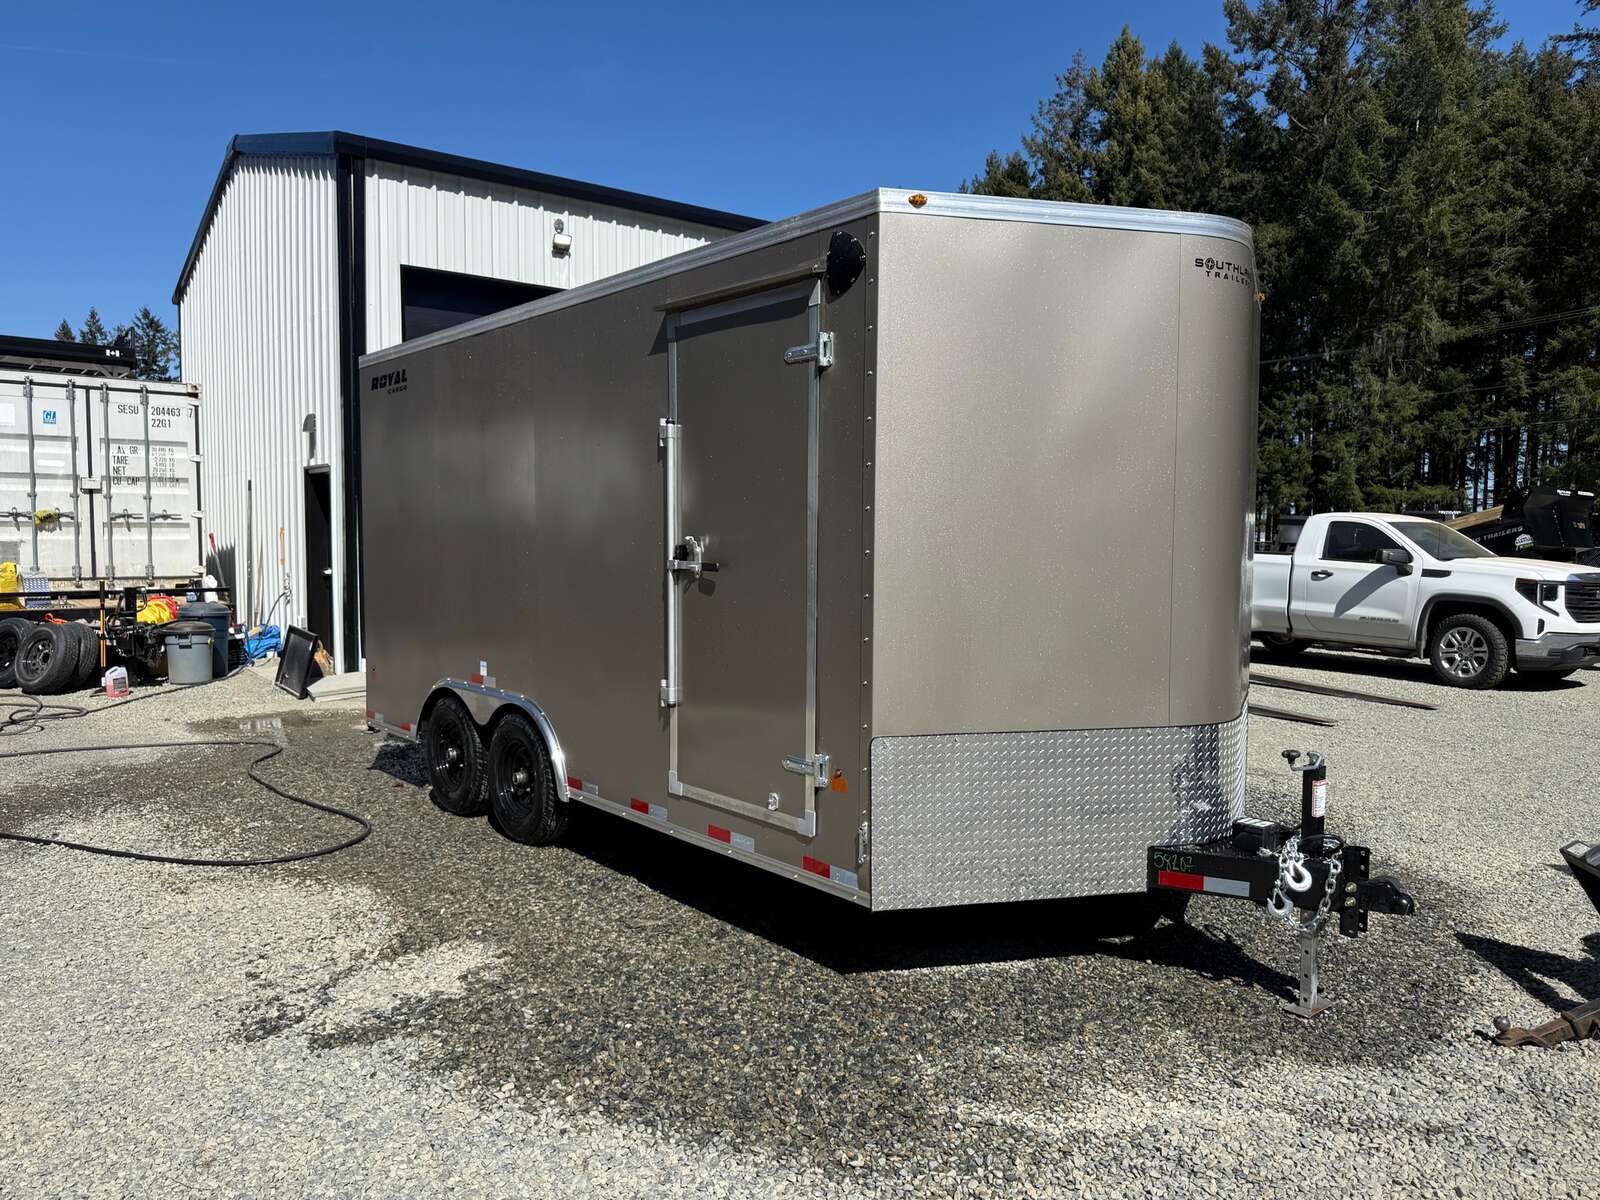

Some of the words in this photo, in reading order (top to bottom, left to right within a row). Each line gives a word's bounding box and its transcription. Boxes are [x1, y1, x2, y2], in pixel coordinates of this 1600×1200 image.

[370, 368, 408, 391] ROYAL
[117, 404, 139, 415] SESU
[150, 406, 181, 417] 204463
[188, 407, 194, 418] 7
[151, 418, 171, 428] 22G1
[112, 455, 129, 465] TARE
[112, 465, 127, 476] NET
